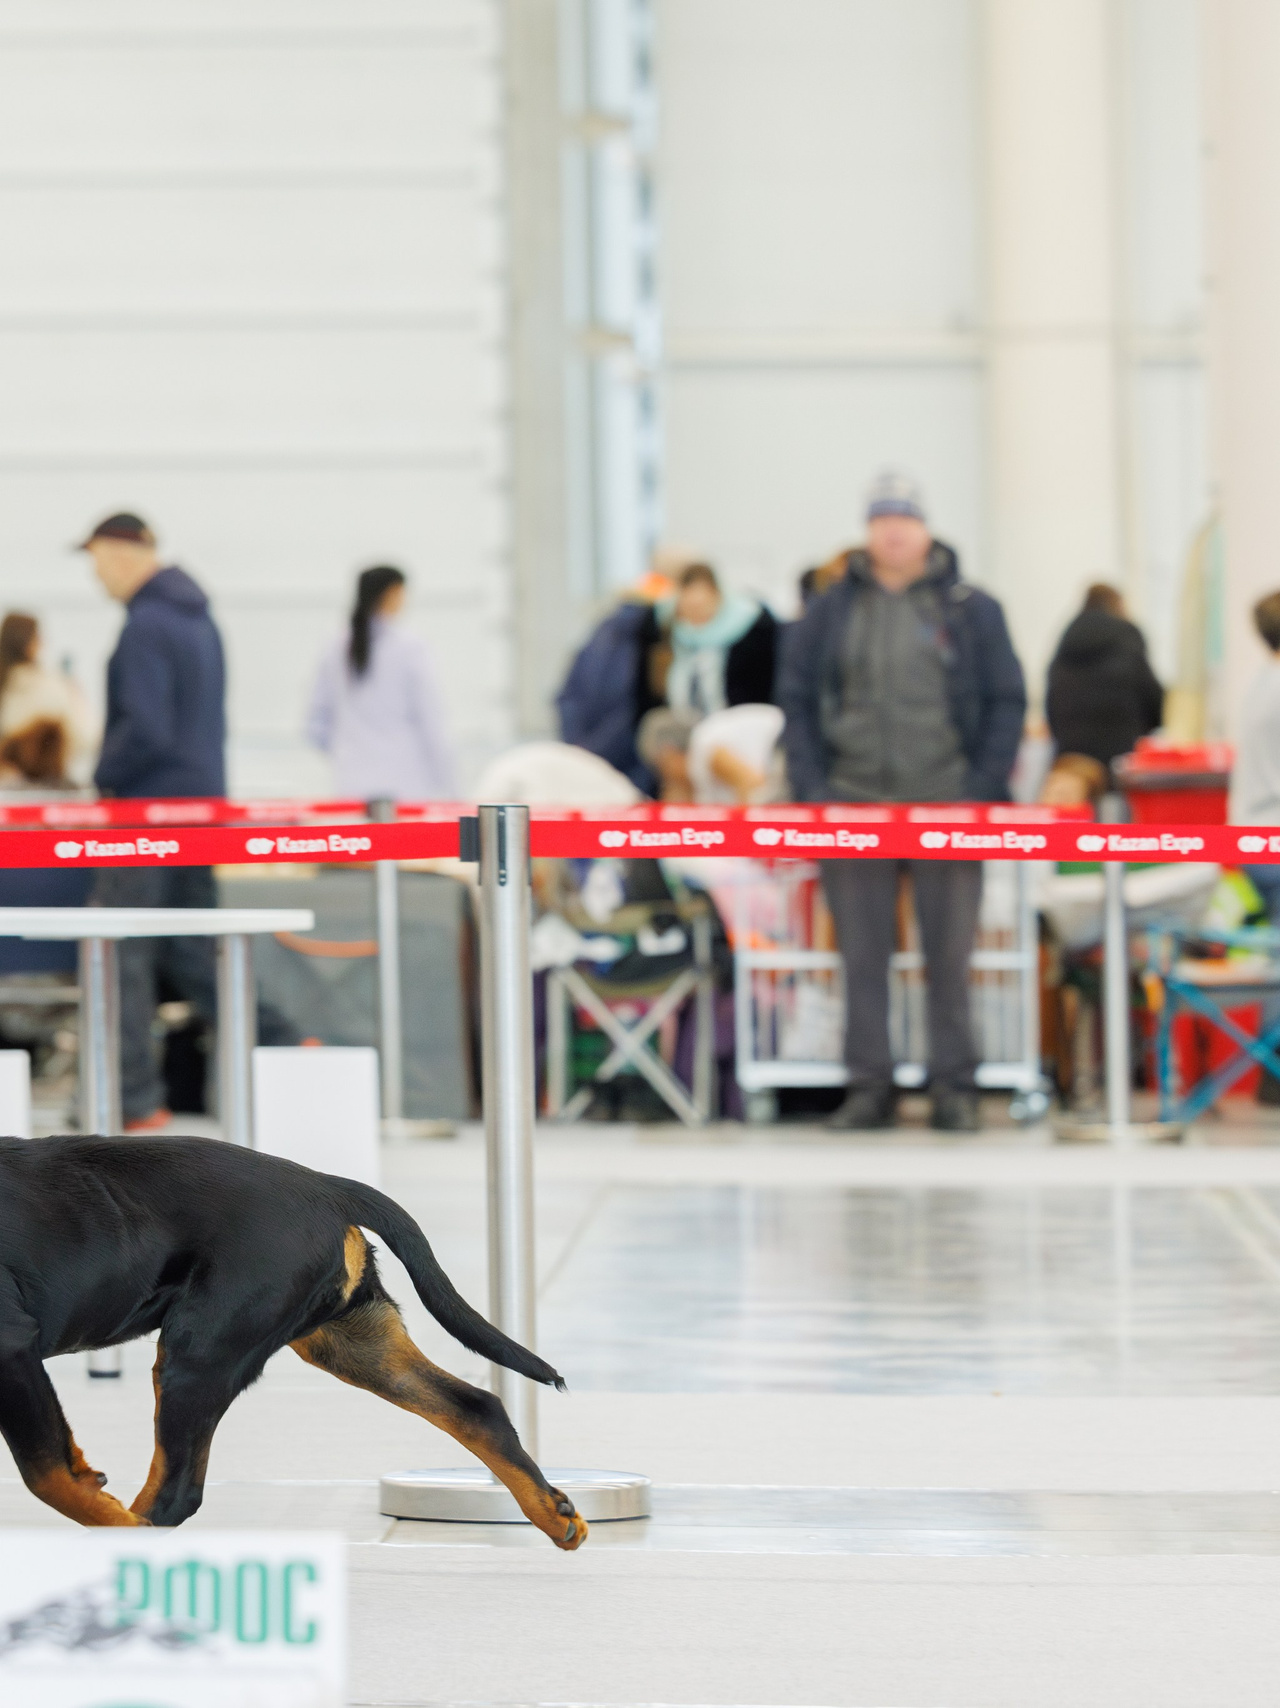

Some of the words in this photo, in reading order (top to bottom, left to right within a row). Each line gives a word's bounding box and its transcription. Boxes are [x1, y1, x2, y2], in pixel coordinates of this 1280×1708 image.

[85, 840, 136, 857] Kazan
[136, 837, 180, 858] Expo
[277, 837, 328, 854] Kazan
[328, 835, 372, 855] Expo
[629, 829, 680, 848] Kazan
[681, 827, 724, 849] Expo
[783, 829, 835, 848] Kazan
[836, 829, 880, 851] Expo
[951, 831, 1002, 850] Kazan
[1003, 831, 1047, 853] Expo
[1106, 835, 1159, 853] Kazan
[1160, 834, 1205, 855] Expo
